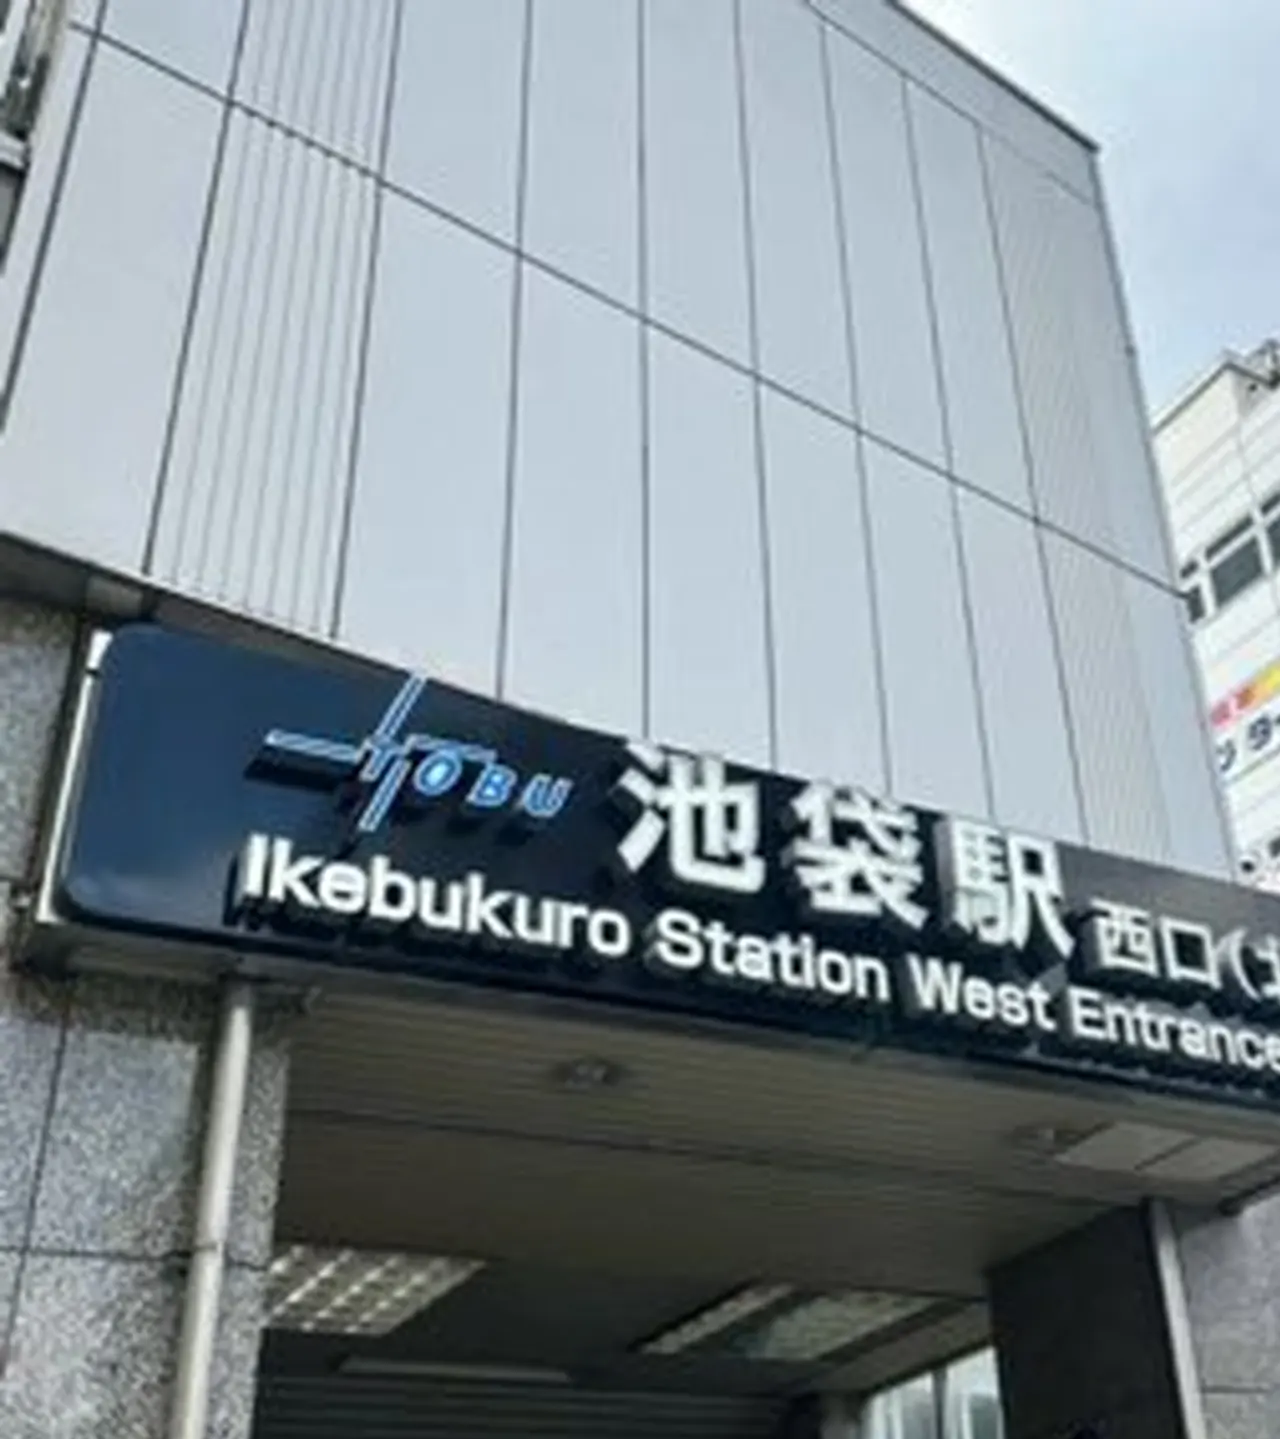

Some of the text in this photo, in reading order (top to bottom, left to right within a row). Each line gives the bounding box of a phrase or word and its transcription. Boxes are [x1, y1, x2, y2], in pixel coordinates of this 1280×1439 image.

[245, 832, 631, 958] Ikebukuro
[655, 910, 891, 1002] Station
[910, 954, 1056, 1034] West
[616, 738, 1074, 960] 池袋駅
